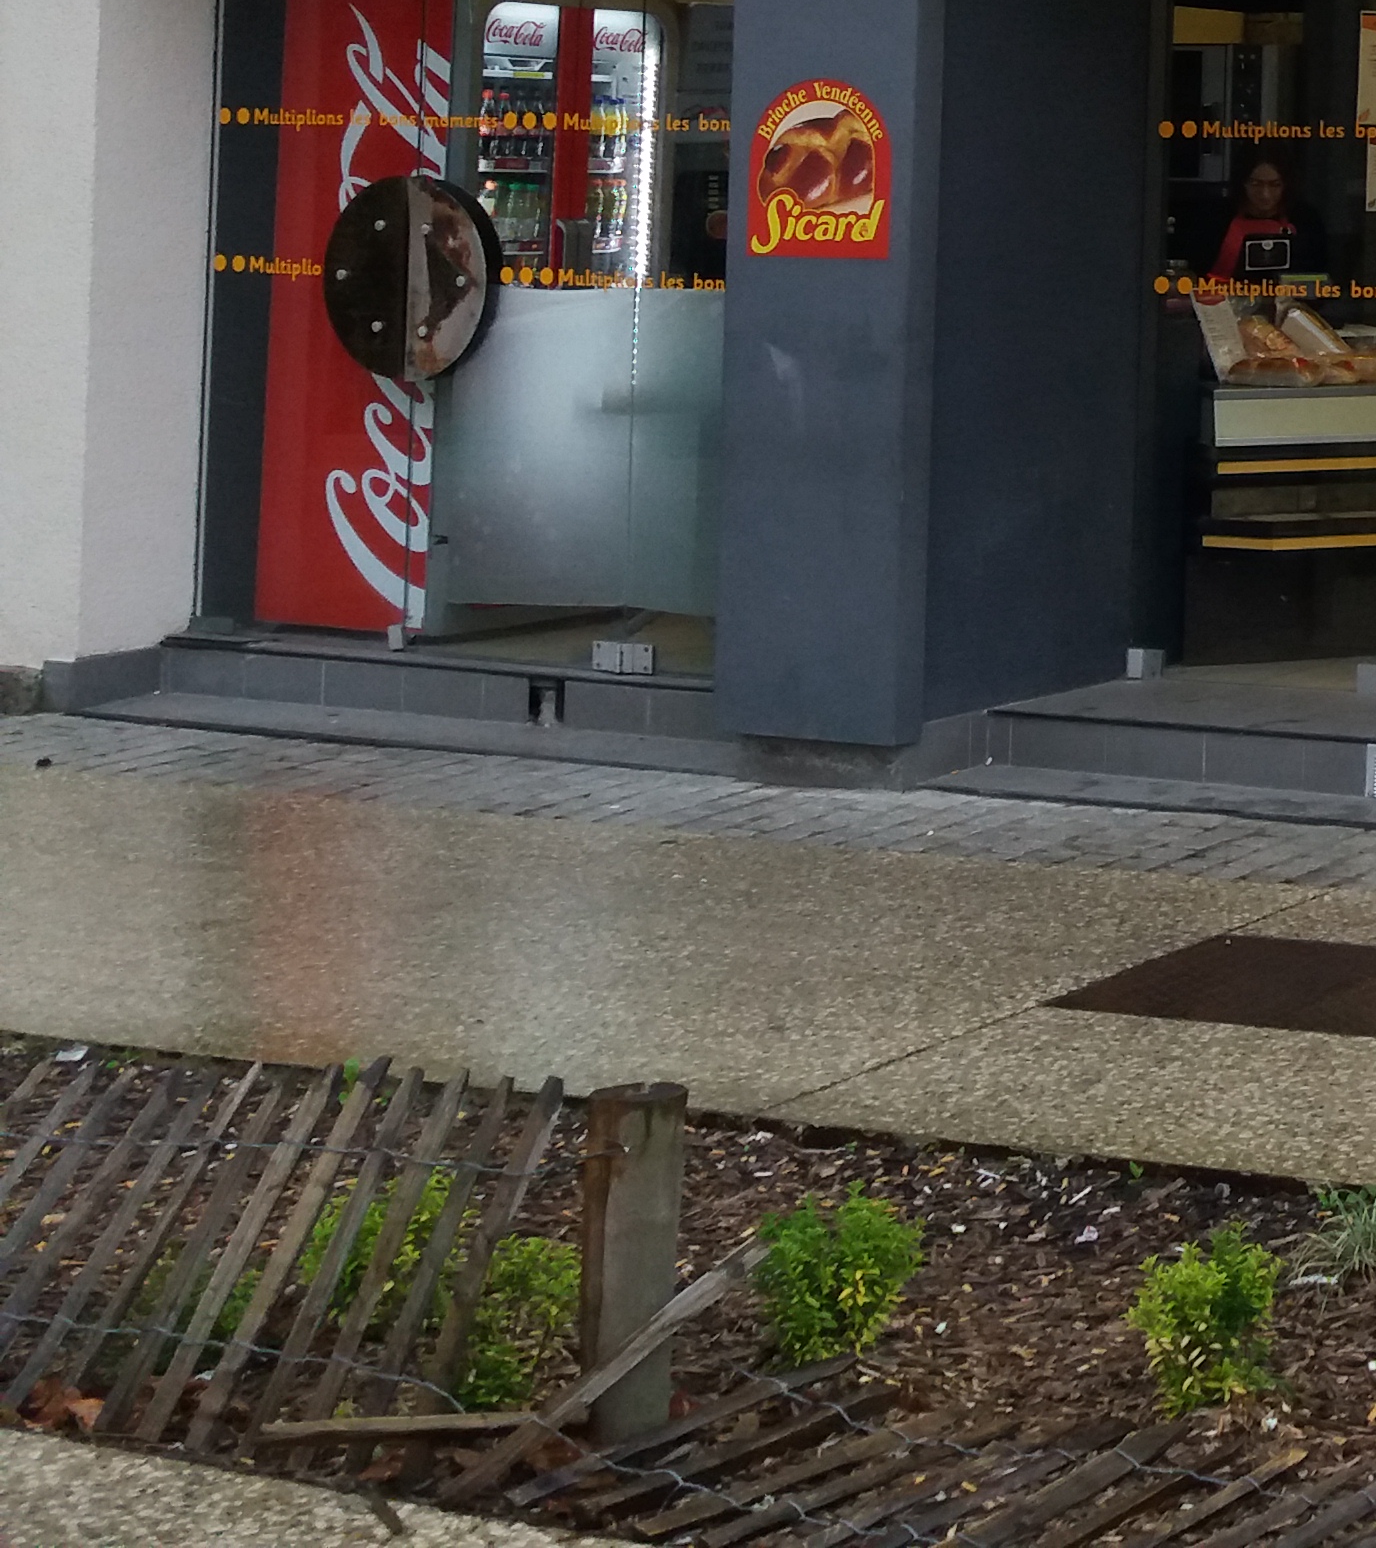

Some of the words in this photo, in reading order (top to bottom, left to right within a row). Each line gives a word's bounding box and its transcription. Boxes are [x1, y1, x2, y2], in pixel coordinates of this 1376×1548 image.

[486, 18, 547, 47] Coca-Cola
[254, 108, 344, 131] Multiplions
[350, 109, 371, 125] les
[379, 110, 417, 126] bons
[424, 111, 499, 129] moments
[666, 112, 690, 132] les
[757, 88, 808, 141] Brioche
[813, 81, 884, 142] Vendéenne
[1202, 120, 1312, 144] Multiplions
[1319, 120, 1345, 139] les
[751, 193, 886, 254] Sicard
[249, 255, 323, 281] Multiplio
[660, 270, 685, 290] les
[1198, 277, 1308, 301] Multiplions
[1315, 277, 1341, 298] les
